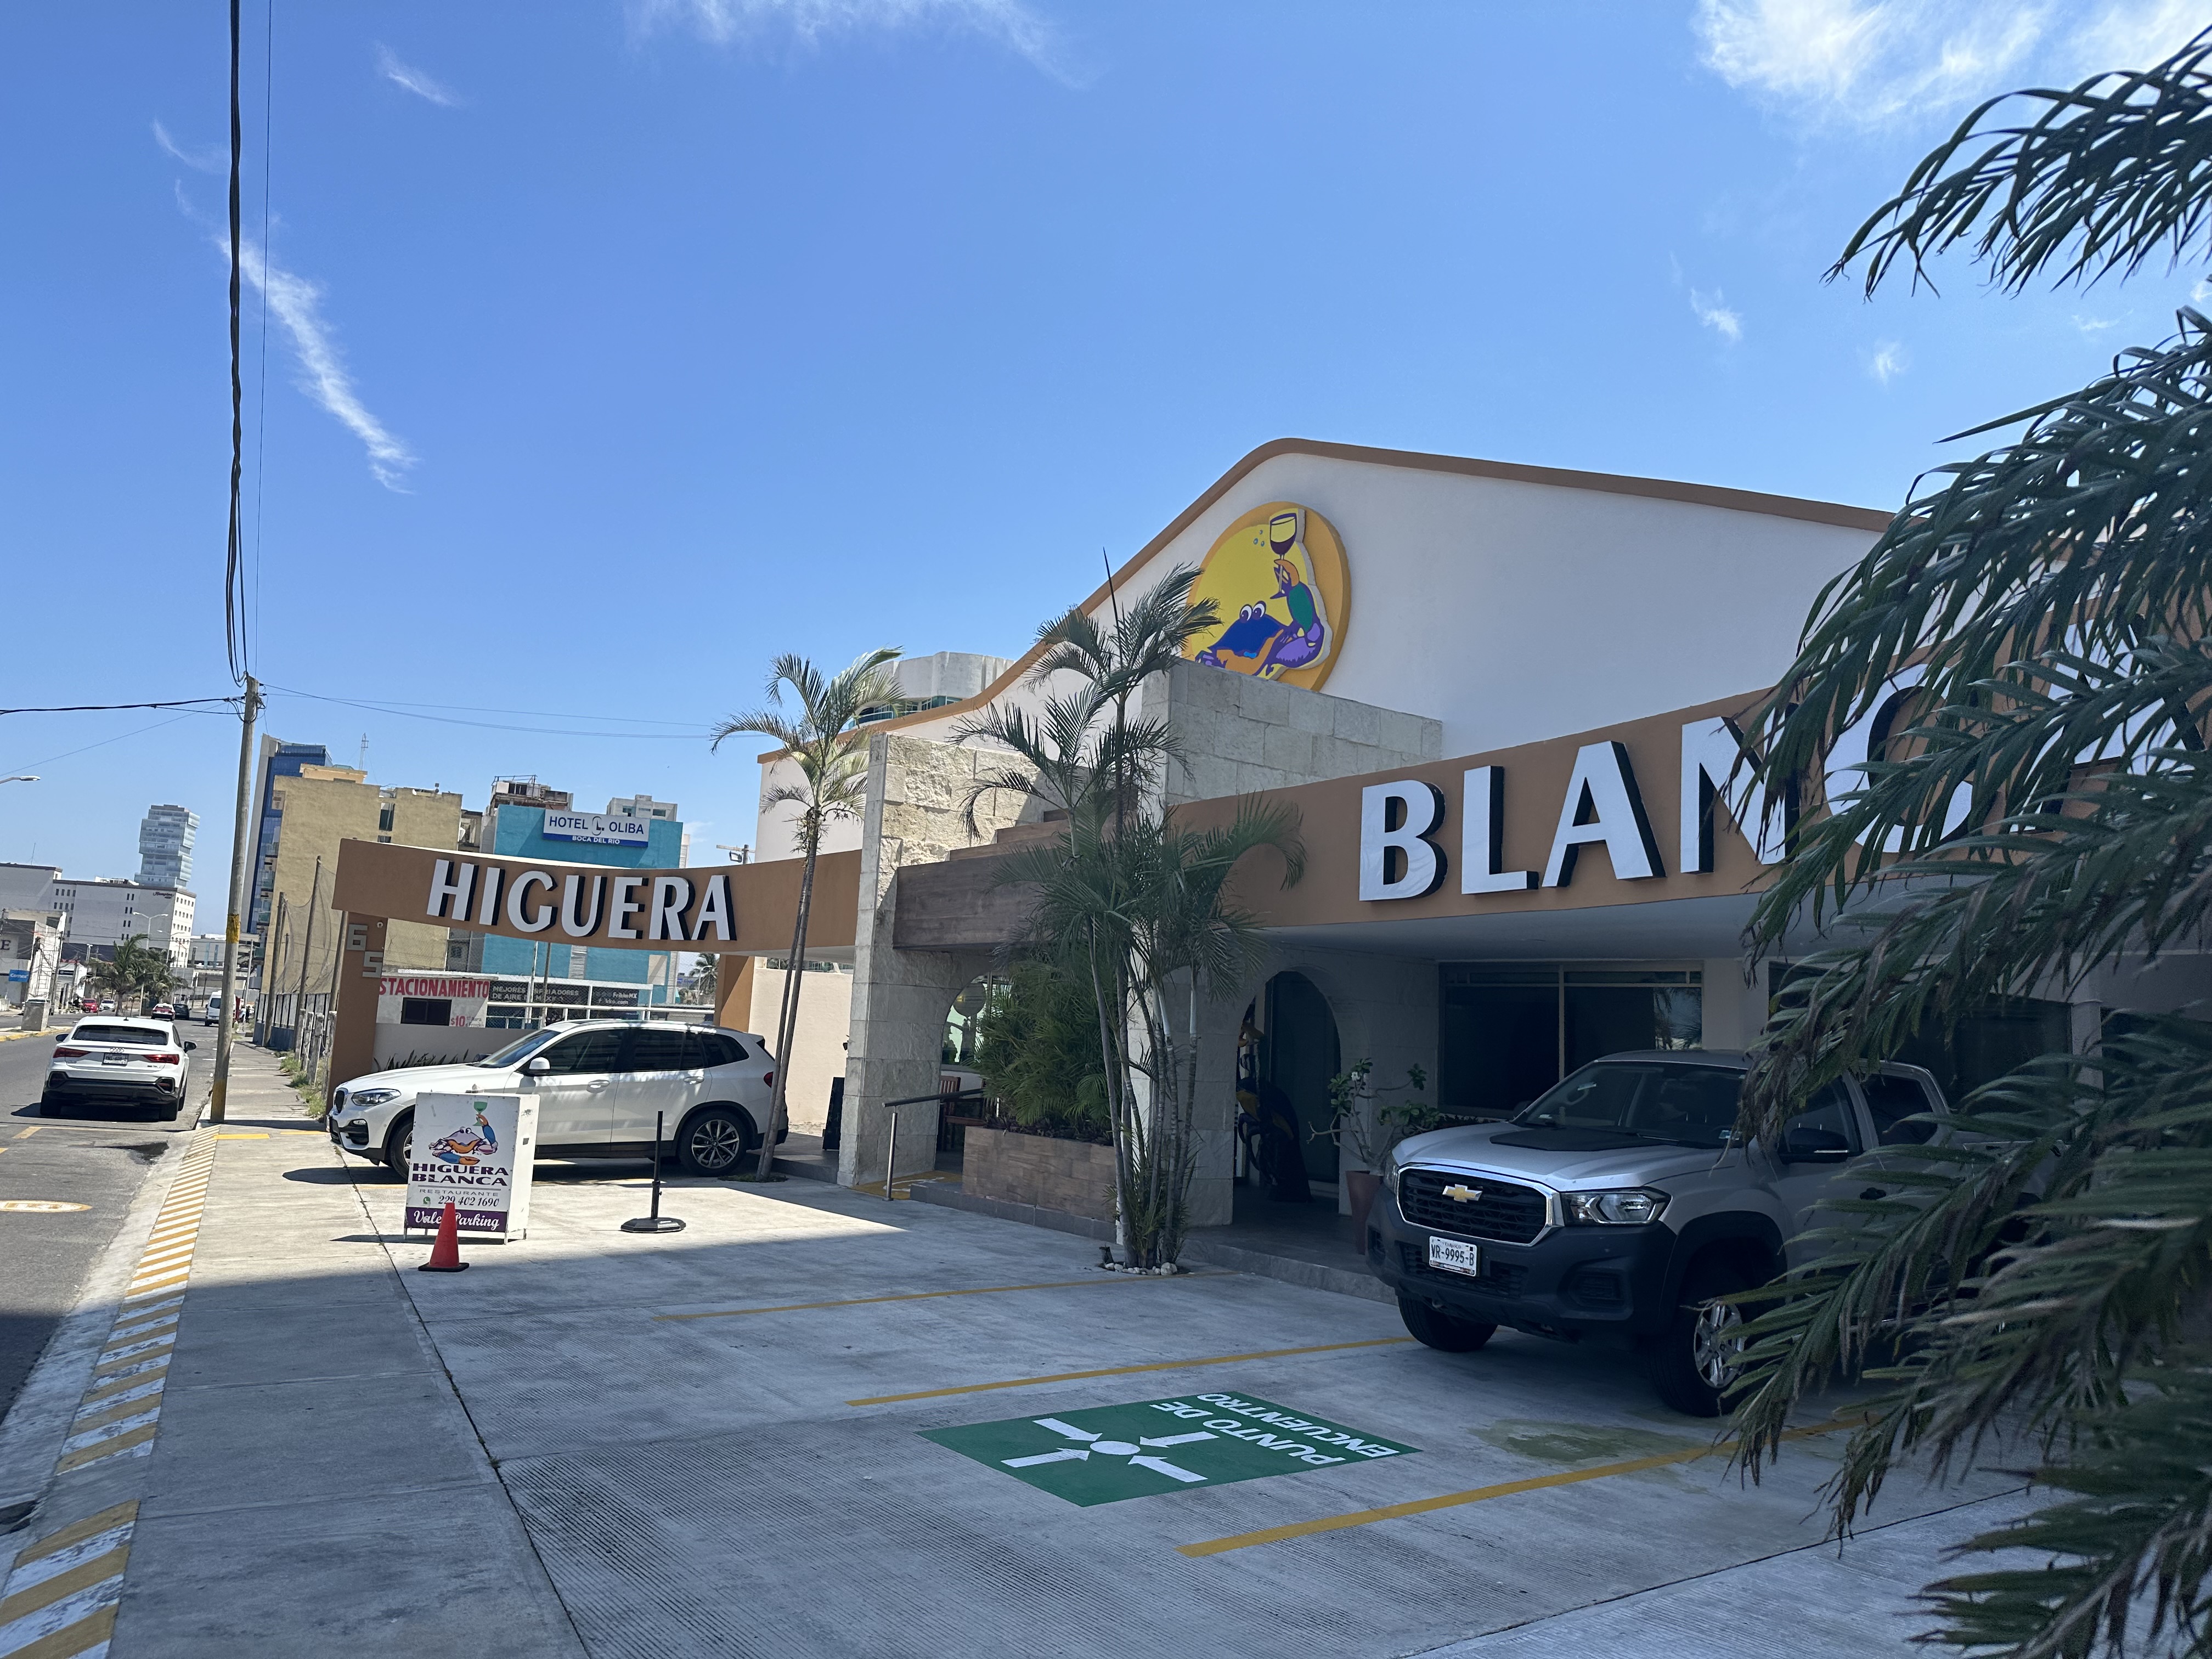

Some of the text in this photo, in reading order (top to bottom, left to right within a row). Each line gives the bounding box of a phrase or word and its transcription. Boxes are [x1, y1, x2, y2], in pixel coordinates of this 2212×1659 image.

[549, 815, 588, 830] HOTEL
[609, 821, 644, 834] OLIBA
[427, 859, 737, 941] HIGUERA
[379, 977, 490, 998] STACIONAMIENTO
[412, 1173, 508, 1186] BLANCA
[413, 1163, 509, 1176] HIGUERA
[438, 1195, 500, 1207] 229 402 1690
[414, 1210, 443, 1224] Vale
[1431, 1244, 1475, 1266] VR-9995-B
[1149, 1401, 1346, 1465] PUNTO DE
[1197, 1393, 1401, 1458] ENCUENTRO
